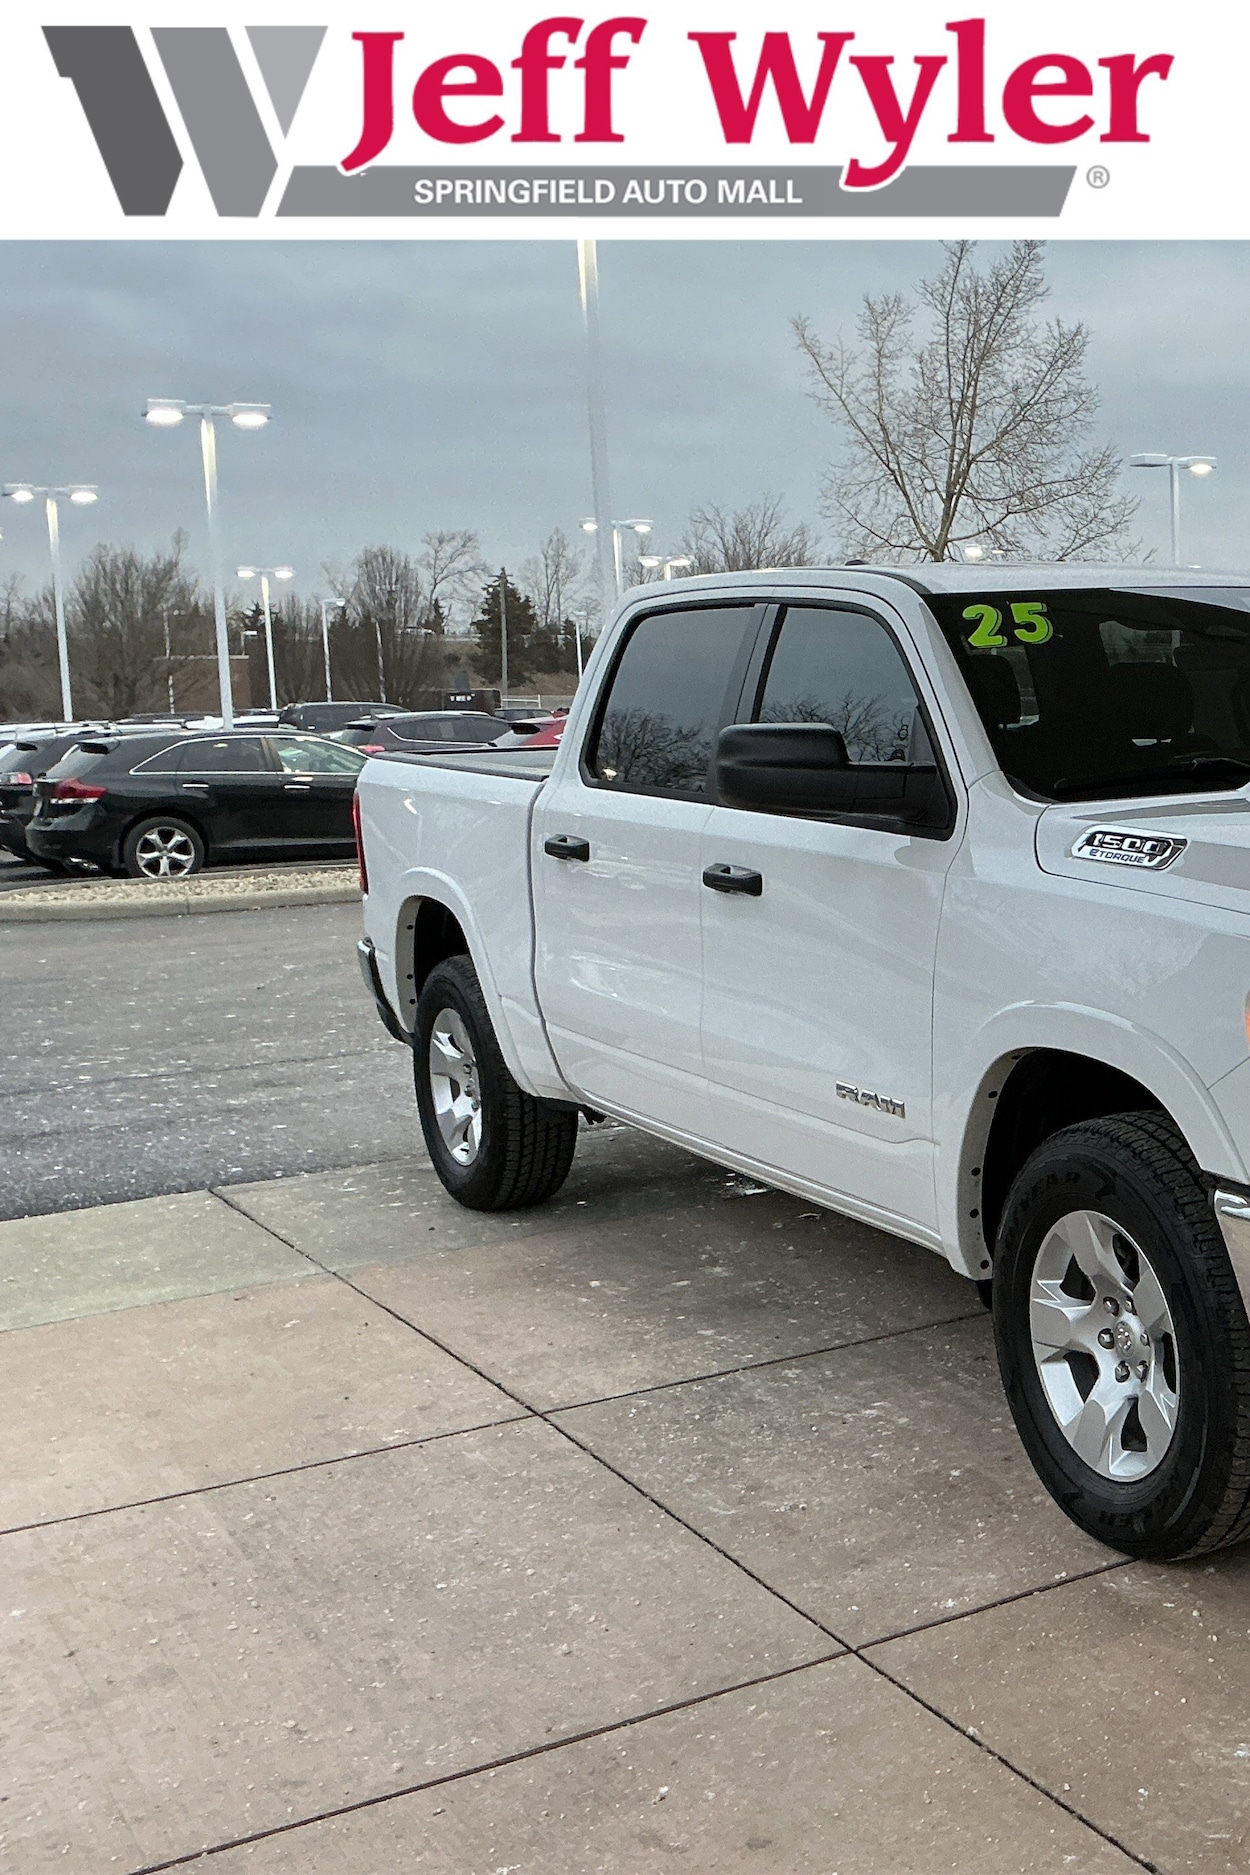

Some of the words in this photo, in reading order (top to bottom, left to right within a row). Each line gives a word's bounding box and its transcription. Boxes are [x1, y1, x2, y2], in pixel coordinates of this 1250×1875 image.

[962, 602, 1053, 648] 25
[1092, 832, 1167, 855] 1500
[835, 1080, 906, 1119] RAM
